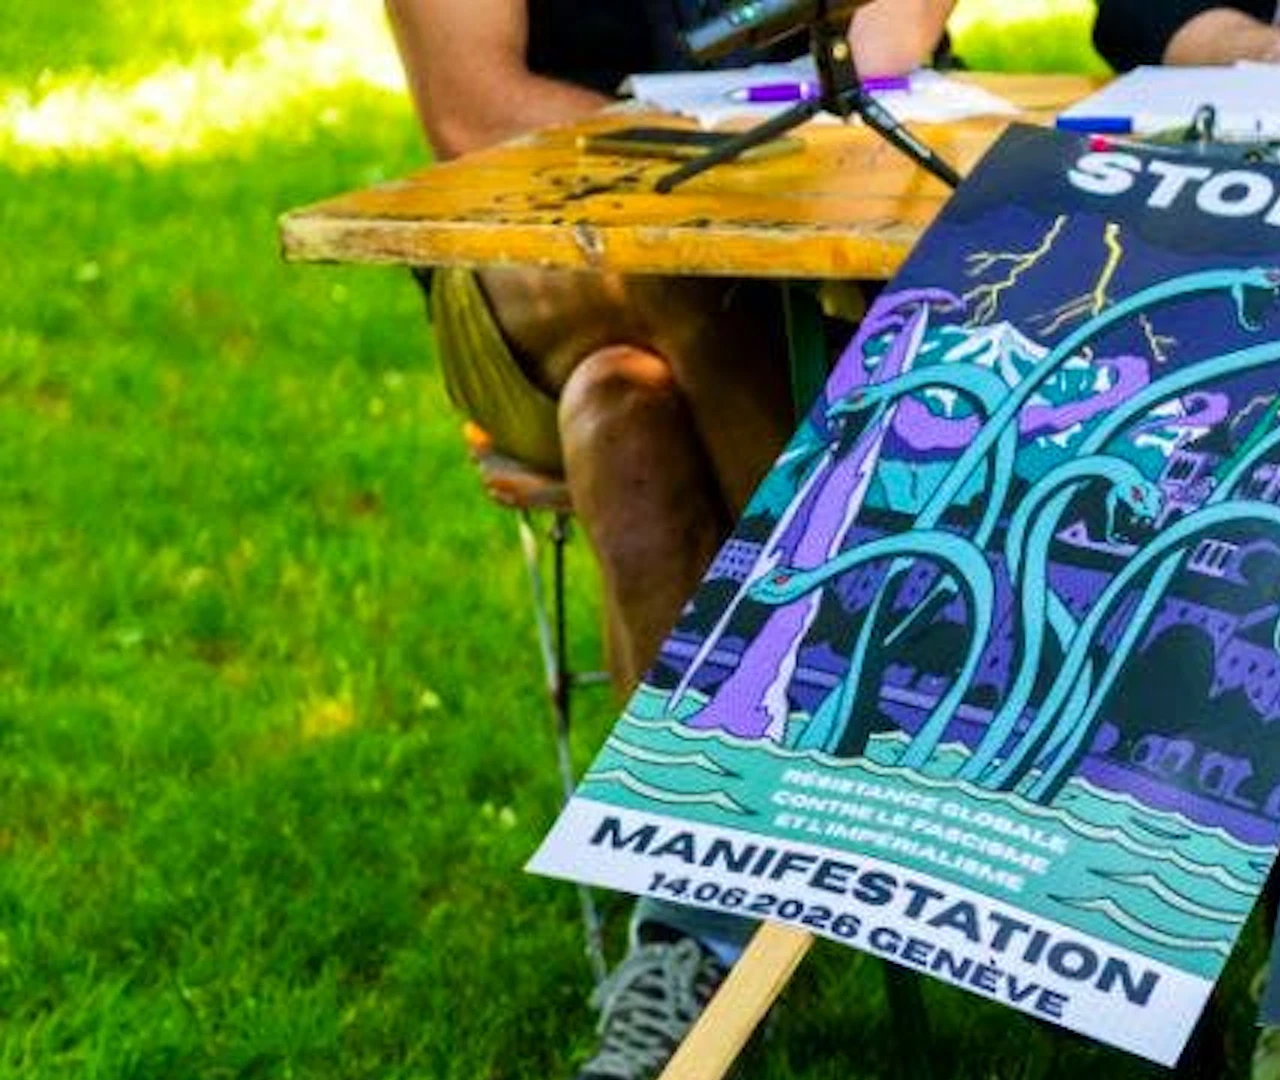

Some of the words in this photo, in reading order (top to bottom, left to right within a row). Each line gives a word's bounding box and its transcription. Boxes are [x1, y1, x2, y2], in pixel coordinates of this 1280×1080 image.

[940, 801, 1069, 855] GLOBALE
[590, 816, 1161, 1007] MANIFESTATION
[867, 926, 1071, 1018] GENÈVE
